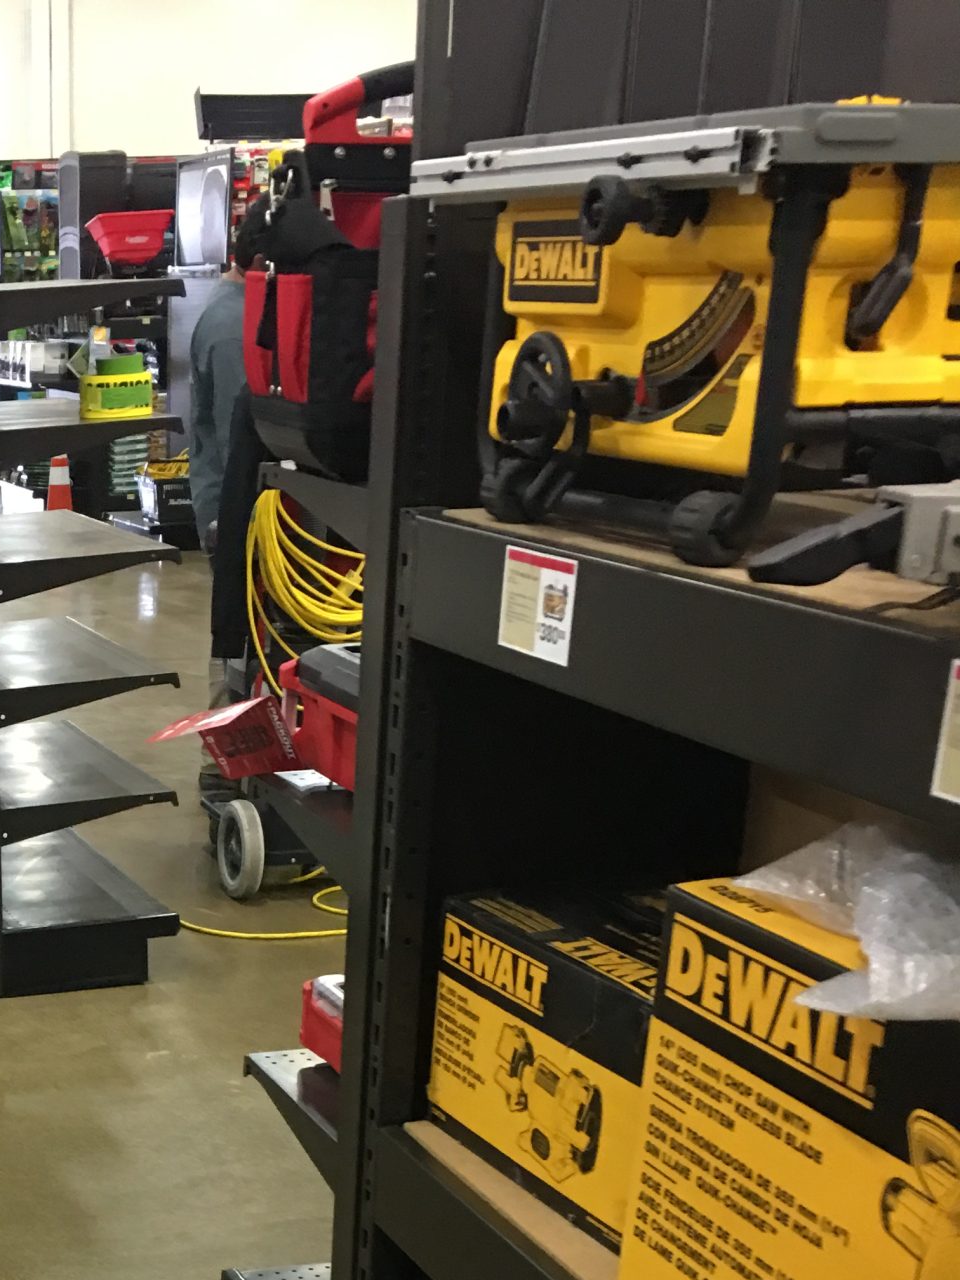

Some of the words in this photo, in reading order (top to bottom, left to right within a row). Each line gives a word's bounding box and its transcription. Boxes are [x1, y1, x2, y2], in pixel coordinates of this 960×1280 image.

[514, 241, 599, 280] DEWALT
[268, 706, 296, 760] PACKOUT
[443, 917, 549, 1012] DEWALT
[665, 922, 885, 1094] DEWALT
[654, 1071, 693, 1105] CHANGE
[694, 1098, 735, 1132] SYSTEM
[724, 1073, 753, 1097] CHOP
[756, 1092, 779, 1115] SAW
[782, 1107, 811, 1135] WITH
[735, 1101, 782, 1140] KEYLESS
[785, 1131, 823, 1165] BLADE
[644, 1140, 661, 1160] SIN
[661, 1152, 691, 1181] LLAVE
[647, 1122, 668, 1143] CON
[669, 1136, 711, 1172] SISTEMA
[713, 1166, 729, 1185] DE
[730, 1177, 773, 1215] CAMBIO
[774, 1207, 790, 1227] DE
[792, 1219, 824, 1250] HOJA
[649, 1104, 683, 1134] SIERRA
[686, 1126, 754, 1180] TRONZADORA
[756, 1173, 772, 1193] DE
[797, 1204, 819, 1224] mm
[638, 1190, 662, 1215] AVEC
[641, 1171, 662, 1195] SCIE
[663, 1187, 715, 1233] FENDEUSE
[715, 1225, 730, 1245] DE
[754, 1256, 774, 1276] mm
[633, 1224, 647, 1243] DE
[647, 1237, 674, 1264] LAME
[636, 1206, 649, 1225] DE
[650, 1218, 717, 1275] CHANGEMENT
